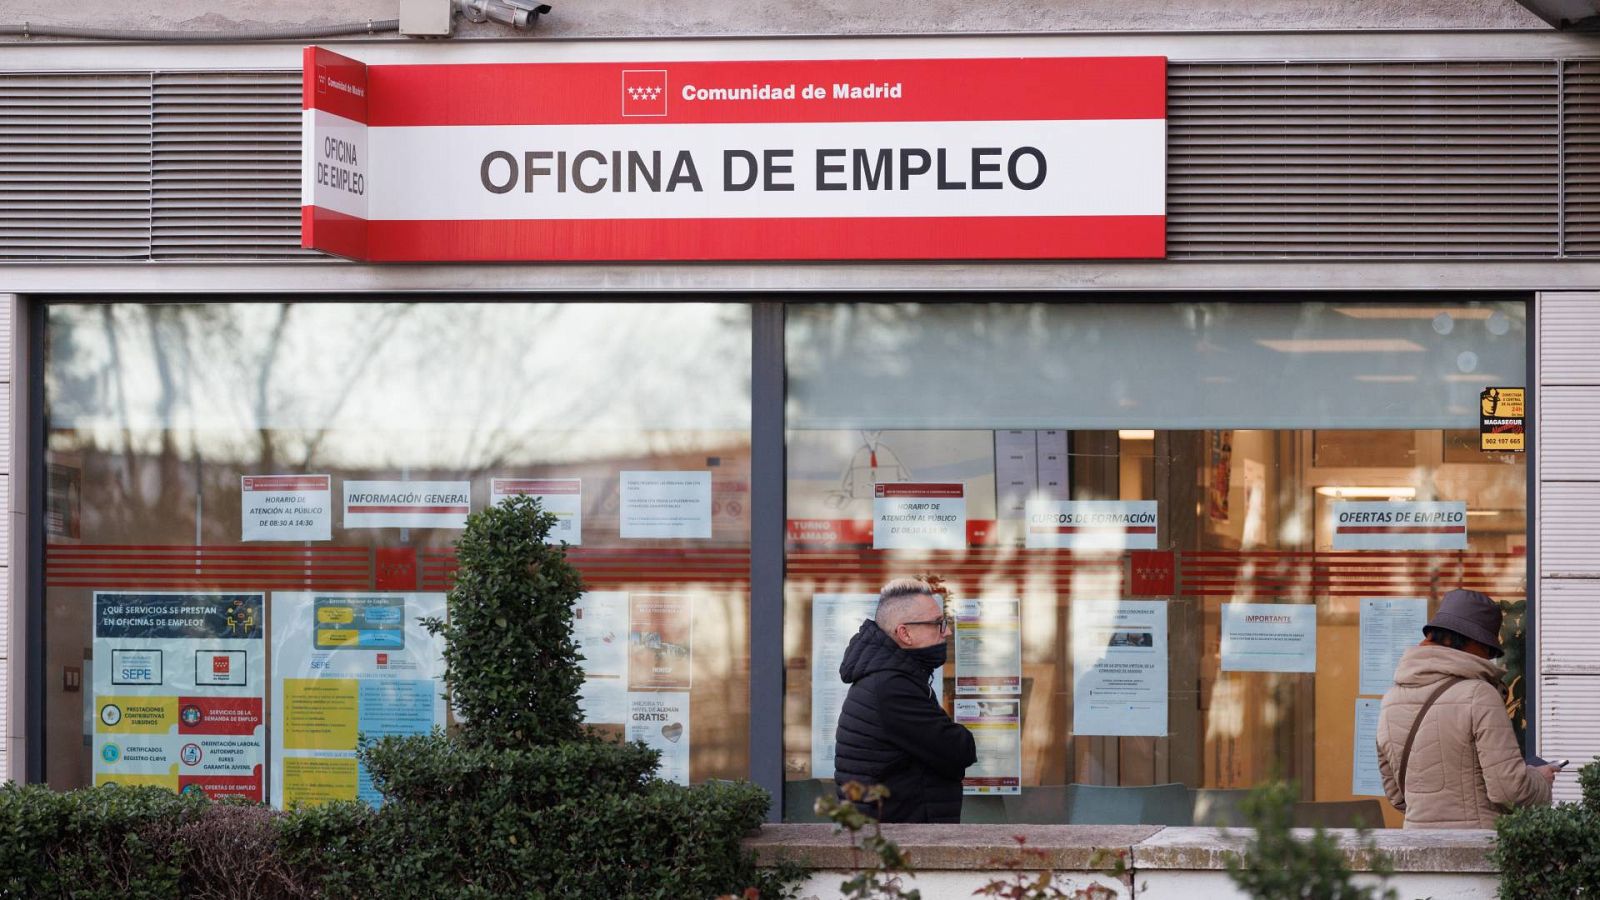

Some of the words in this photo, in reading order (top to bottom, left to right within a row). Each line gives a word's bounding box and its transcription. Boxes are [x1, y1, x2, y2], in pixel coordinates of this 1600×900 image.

[682, 84, 795, 102] Comunidad
[802, 84, 826, 100] de
[832, 82, 902, 100] Madrid
[325, 136, 358, 167] OFICINA
[480, 149, 703, 194] OFICINA
[723, 149, 795, 192] DE
[815, 146, 1048, 191] EMPLEO
[318, 162, 329, 186] DE
[331, 167, 365, 196] EMPLEO
[348, 492, 422, 504] INFORMACIÓN
[424, 493, 470, 503] GENERAL
[250, 506, 284, 514] ATENCIÓN
[294, 506, 322, 514] PÚBLICO
[881, 514, 917, 522] ATENCIÓN
[928, 514, 957, 522] PÚBLICO
[1032, 513, 1073, 524] CURSOS
[1075, 514, 1089, 524] DE
[1091, 512, 1156, 524] FORMACIÓN
[1339, 512, 1392, 523] OFERTAS
[1395, 512, 1411, 522] DE
[1414, 512, 1463, 522] EMPLEO
[295, 519, 313, 527] 14:30
[793, 522, 831, 530] TURNO
[103, 605, 123, 615] ¿QUÉ
[125, 606, 167, 614] SERVICIOS
[180, 606, 217, 614] PRESTAN
[104, 618, 115, 626] EN
[116, 618, 154, 626] OFICINAS
[156, 618, 166, 626] DE
[168, 618, 204, 626] EMPLEO?
[1245, 615, 1292, 624] IMPORTANTE
[122, 668, 151, 680] SEPE
[632, 713, 668, 721] GRATIS!
